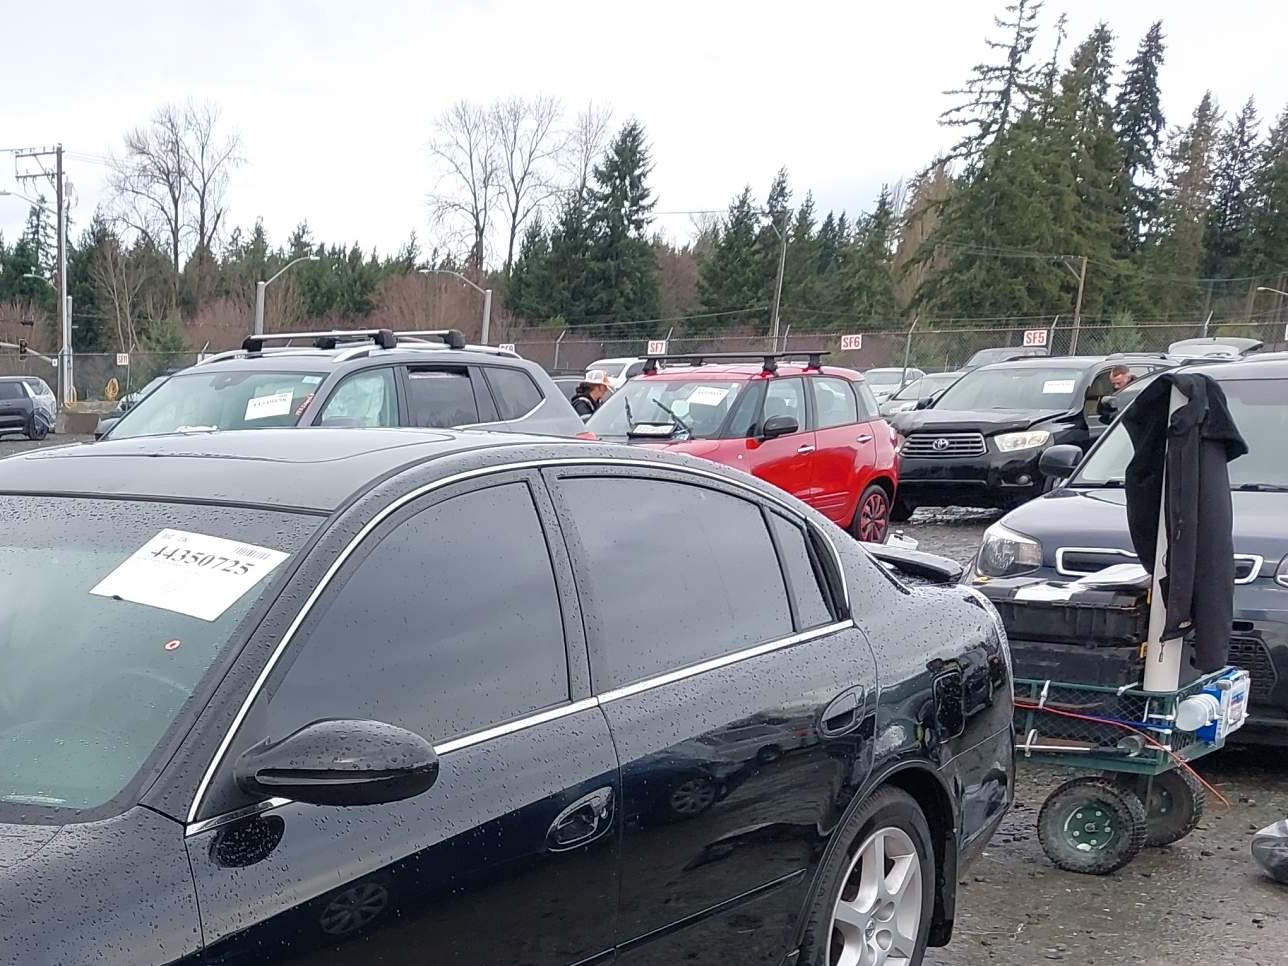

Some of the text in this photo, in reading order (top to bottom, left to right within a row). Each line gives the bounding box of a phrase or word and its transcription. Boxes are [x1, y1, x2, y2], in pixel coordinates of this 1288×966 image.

[843, 336, 860, 348] SF6
[1026, 332, 1045, 344] SF5
[151, 546, 255, 575] 44350725
